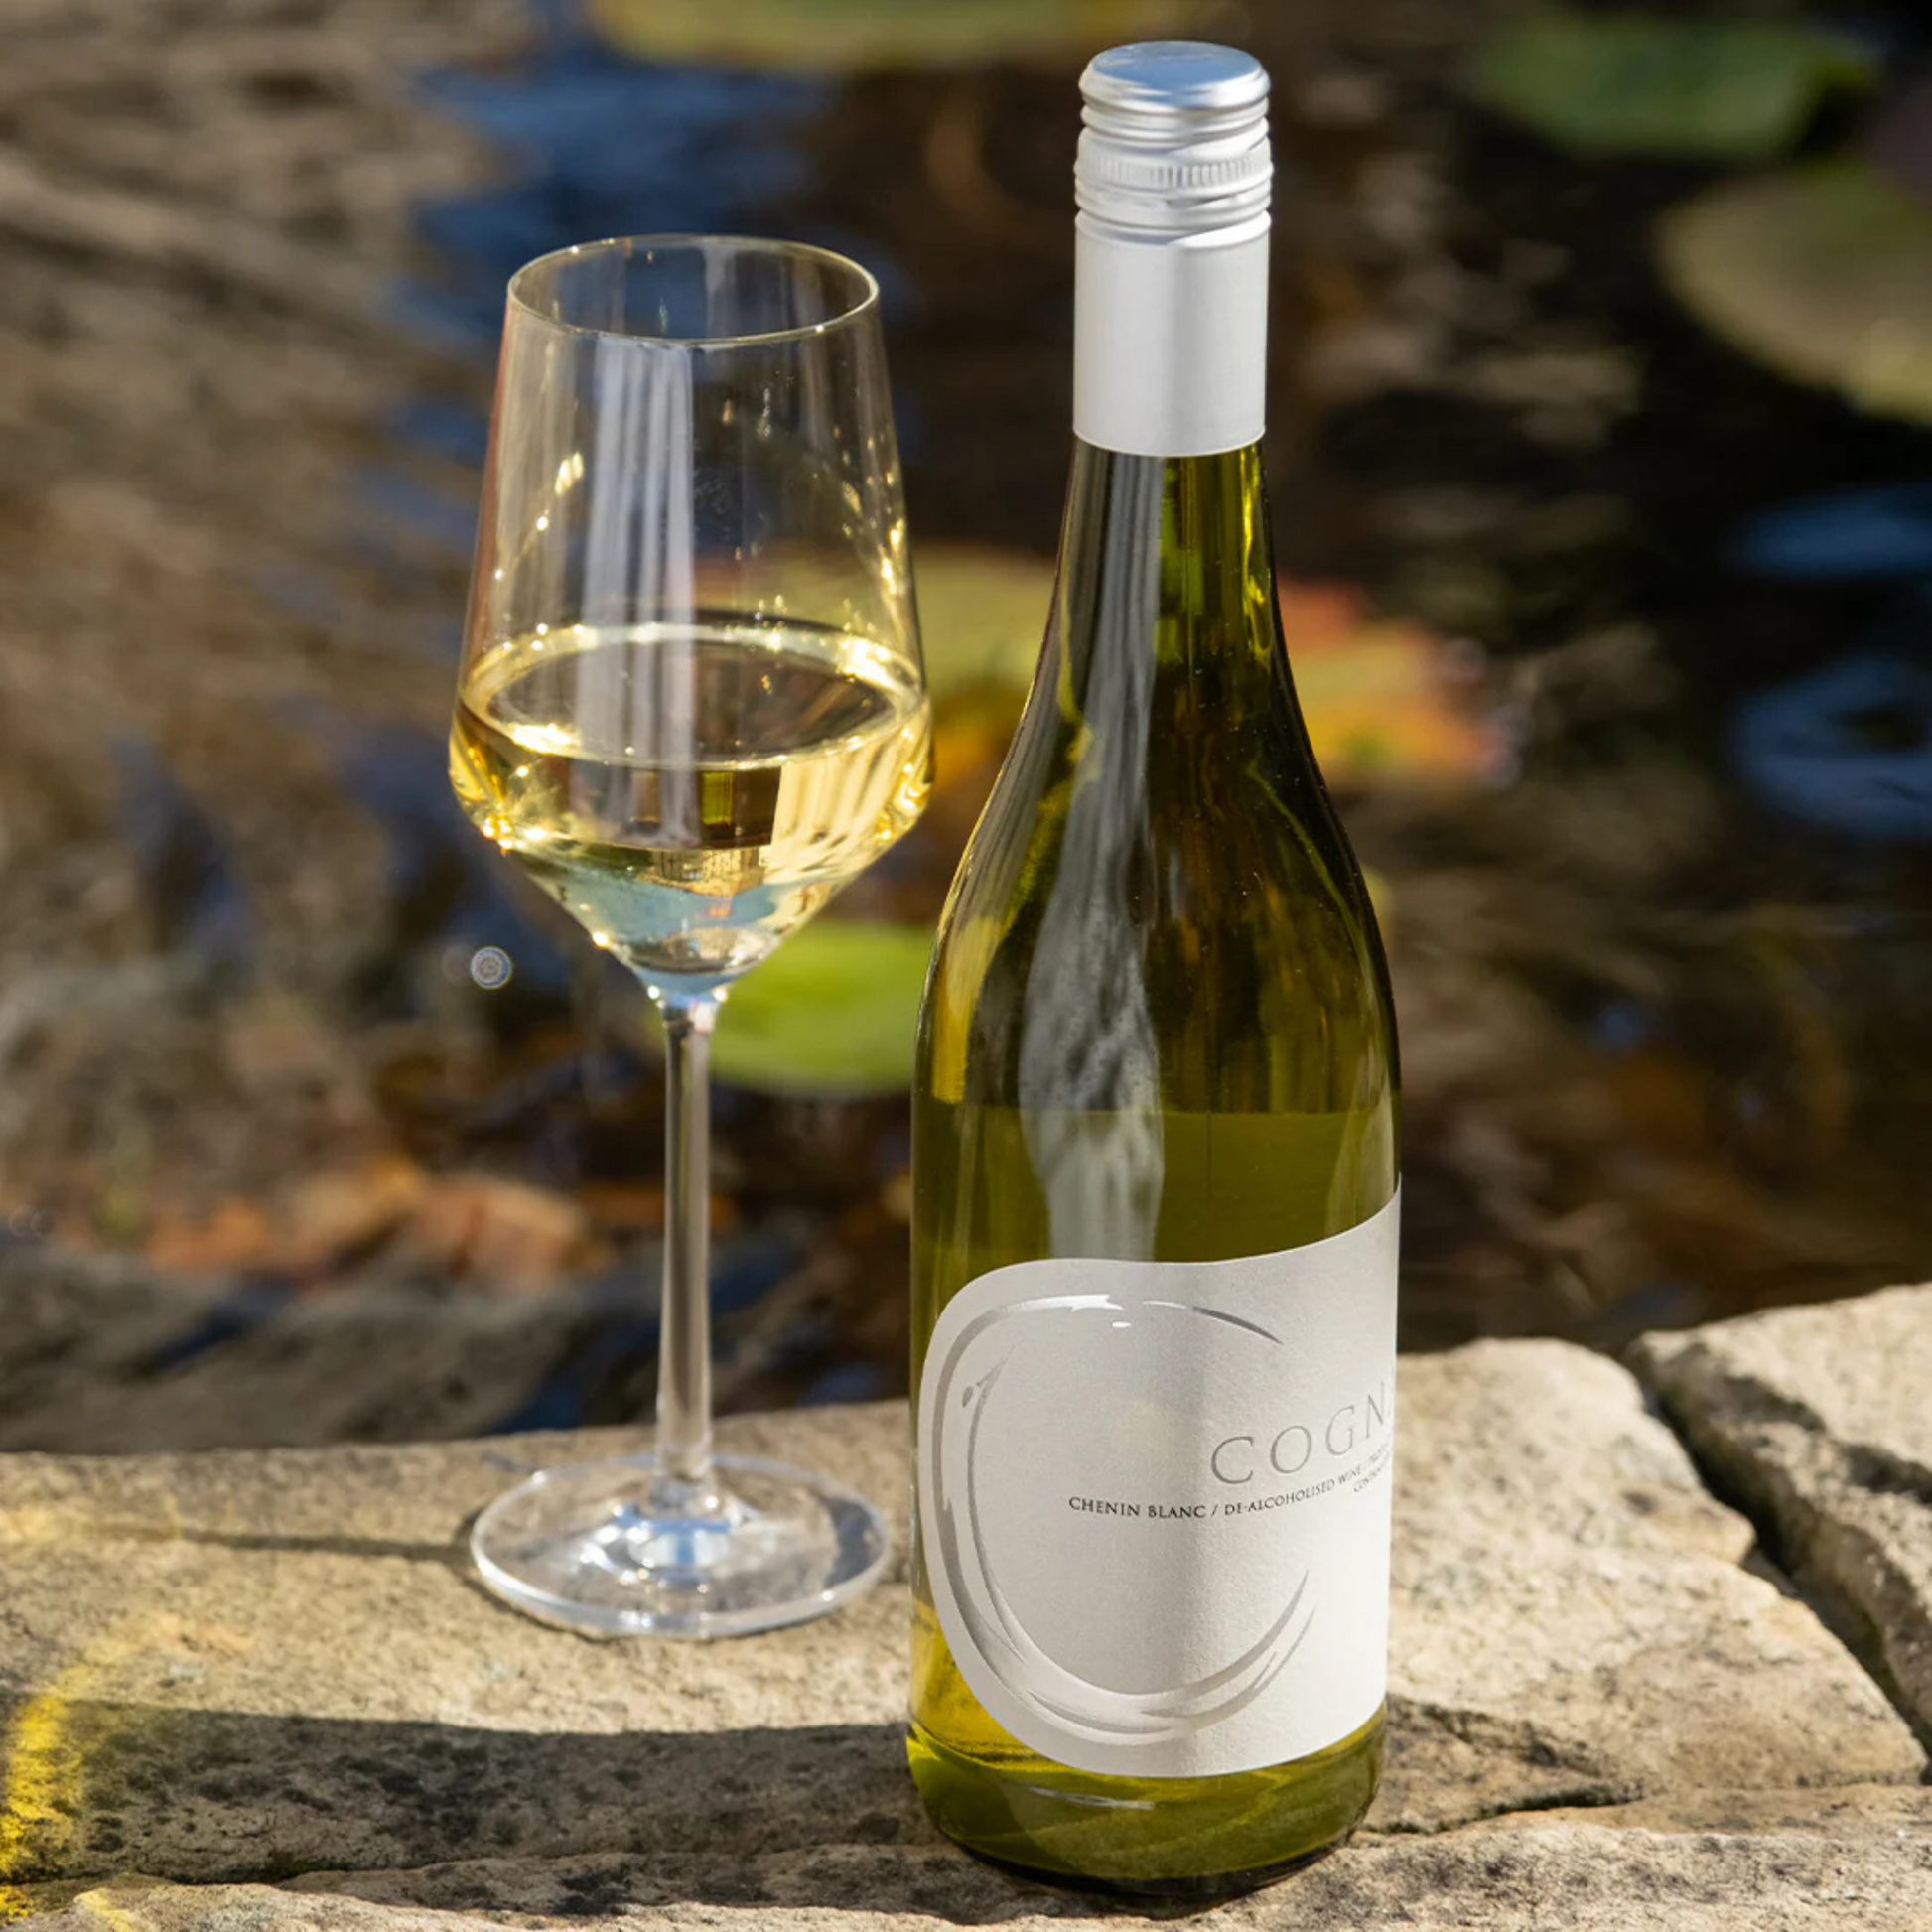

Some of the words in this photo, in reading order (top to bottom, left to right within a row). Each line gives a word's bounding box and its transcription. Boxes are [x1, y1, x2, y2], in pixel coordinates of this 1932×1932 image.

[1210, 1380, 1390, 1484] COGN
[1068, 1496, 1141, 1517] CHENIN
[1148, 1505, 1206, 1519] BLANC
[1224, 1478, 1335, 1517] DE-ALCOHOLISED
[1338, 1463, 1362, 1485] WINE
